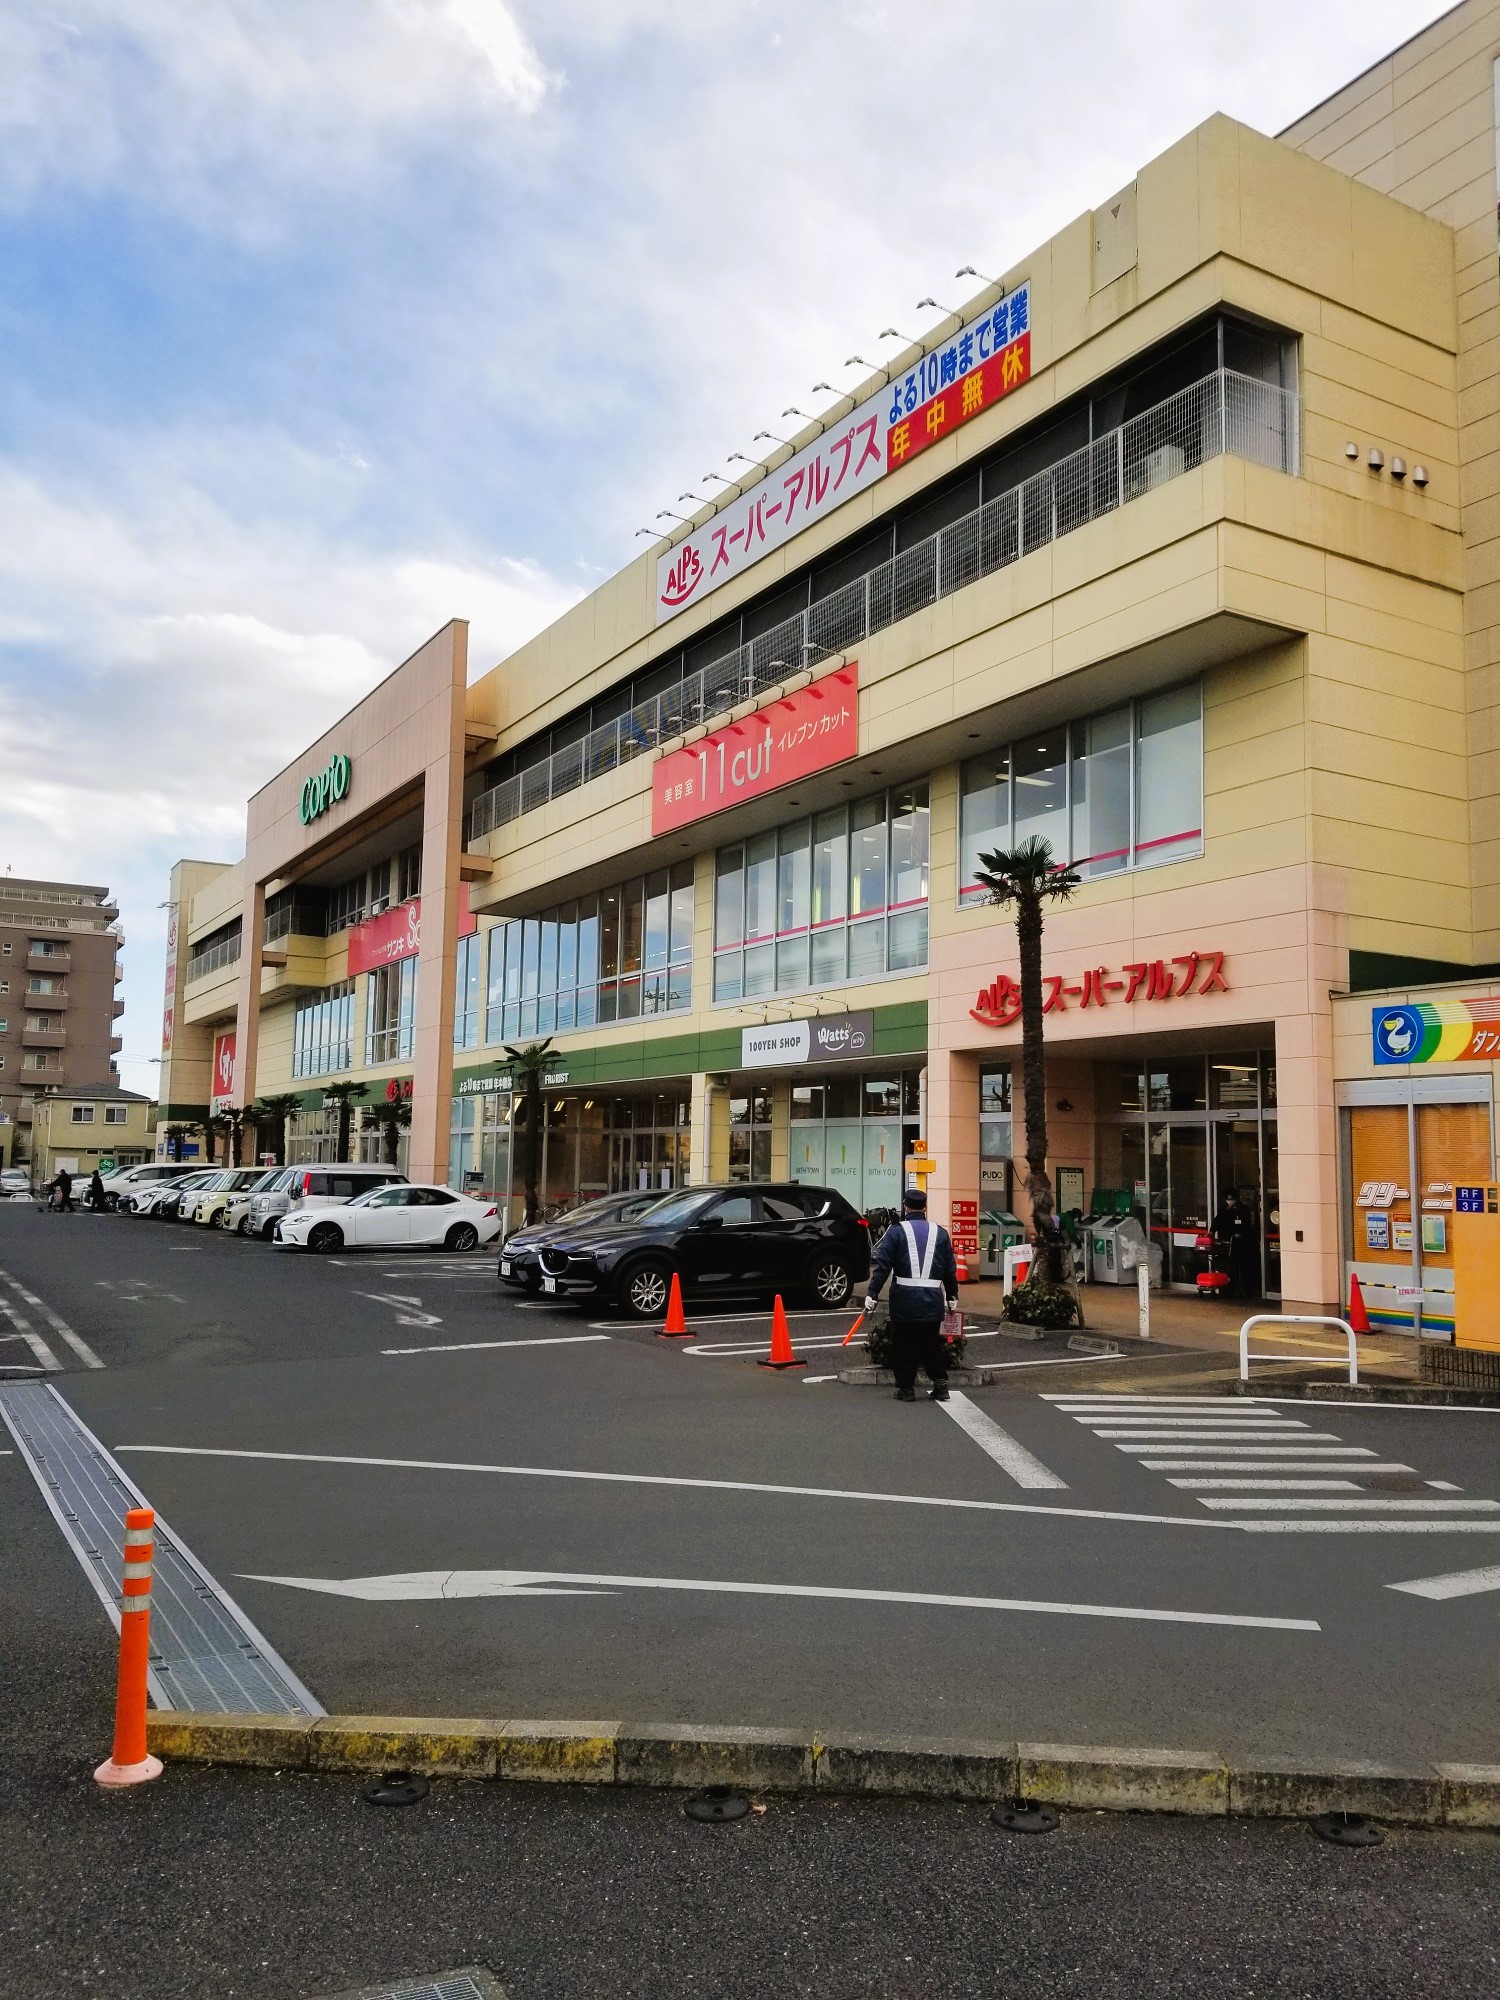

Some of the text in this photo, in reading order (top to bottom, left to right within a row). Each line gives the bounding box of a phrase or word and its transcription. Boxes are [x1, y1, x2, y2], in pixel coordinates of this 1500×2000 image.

[889, 289, 1028, 424] よる10時まで営業
[892, 345, 1024, 459] 年中無休
[664, 414, 880, 596] ALPS スーパーアルプス
[664, 778, 694, 805] 美容室
[778, 706, 850, 752] イレブンカット
[974, 951, 1229, 1018] ALPS スーパーアルプス
[779, 1036, 801, 1048] SHOP
[817, 1027, 850, 1044] Watts
[1473, 1030, 1500, 1054] ダン
[982, 1170, 1003, 1179] PUDO
[1462, 1202, 1479, 1212] 3F
